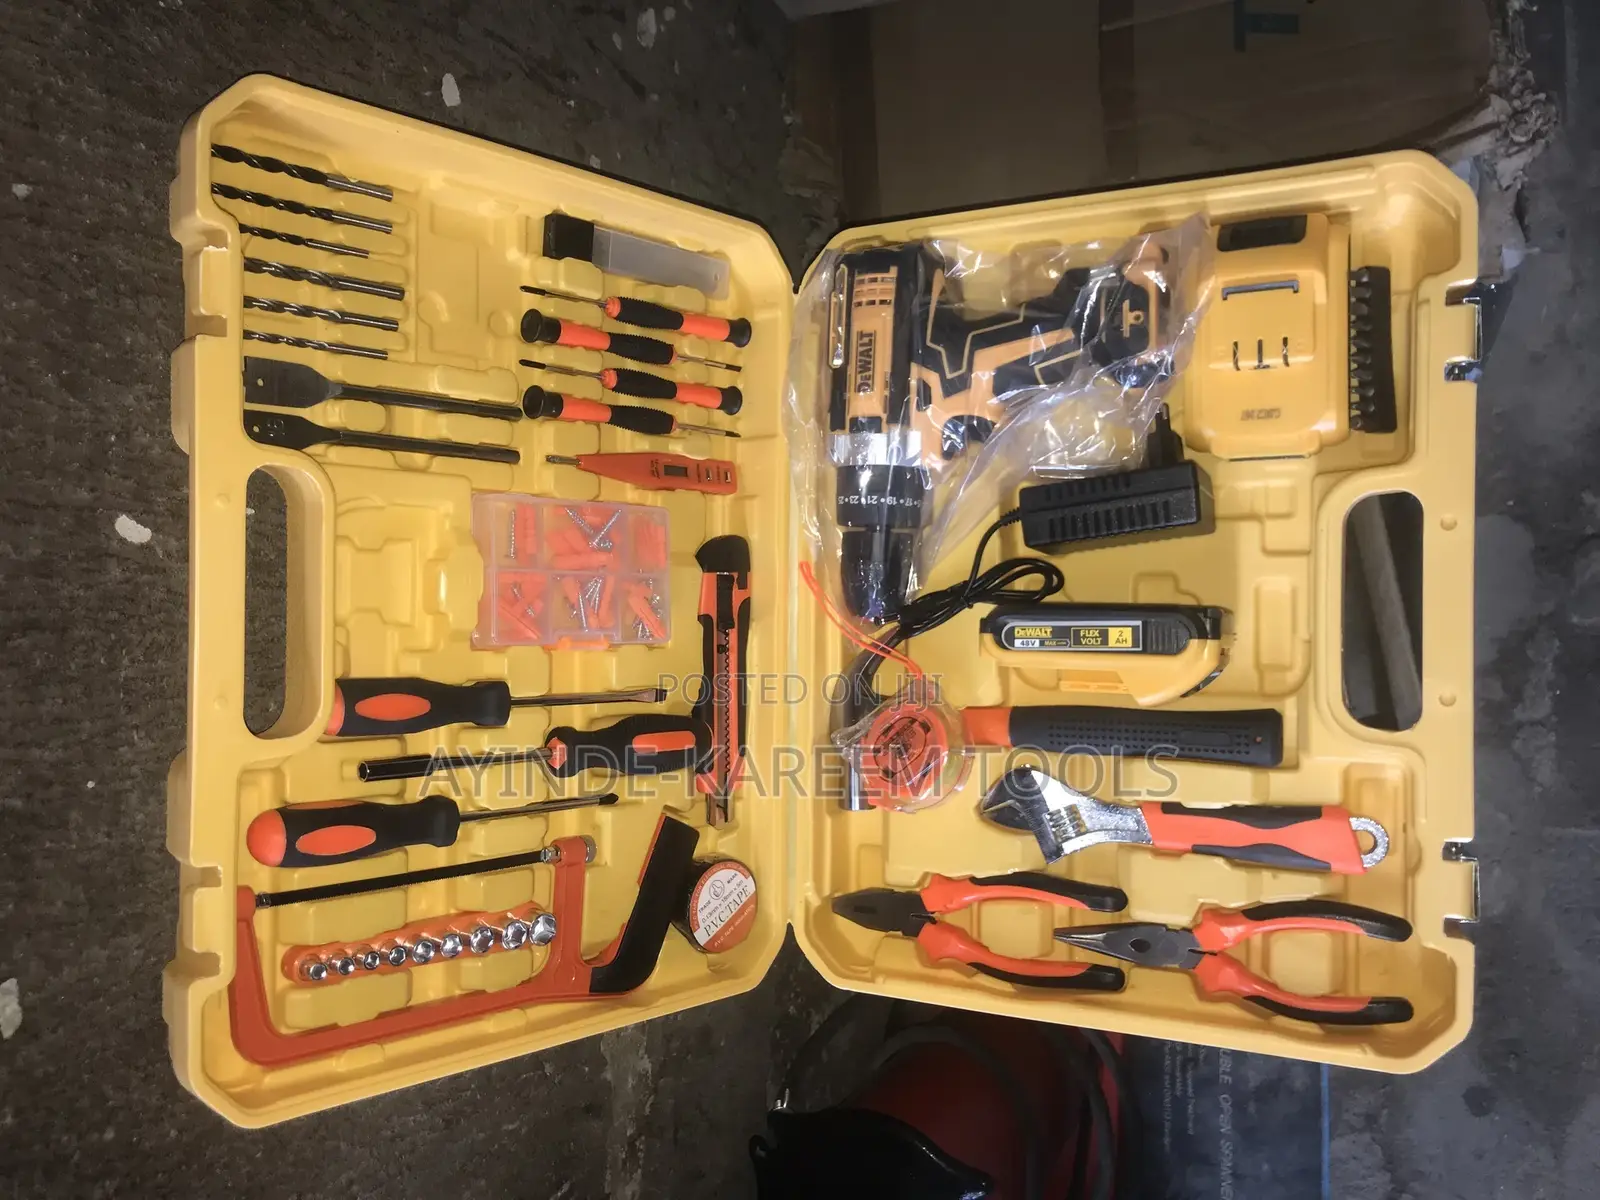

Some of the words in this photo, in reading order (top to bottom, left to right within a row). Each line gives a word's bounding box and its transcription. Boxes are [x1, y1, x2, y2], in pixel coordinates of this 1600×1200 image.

[849, 495, 859, 504] 23
[867, 495, 878, 505] 21
[886, 496, 898, 505] 19
[1015, 627, 1052, 638] DEWALT
[1080, 629, 1100, 637] FLEX
[1080, 637, 1102, 645] VOLT
[698, 900, 711, 914] TRADE
